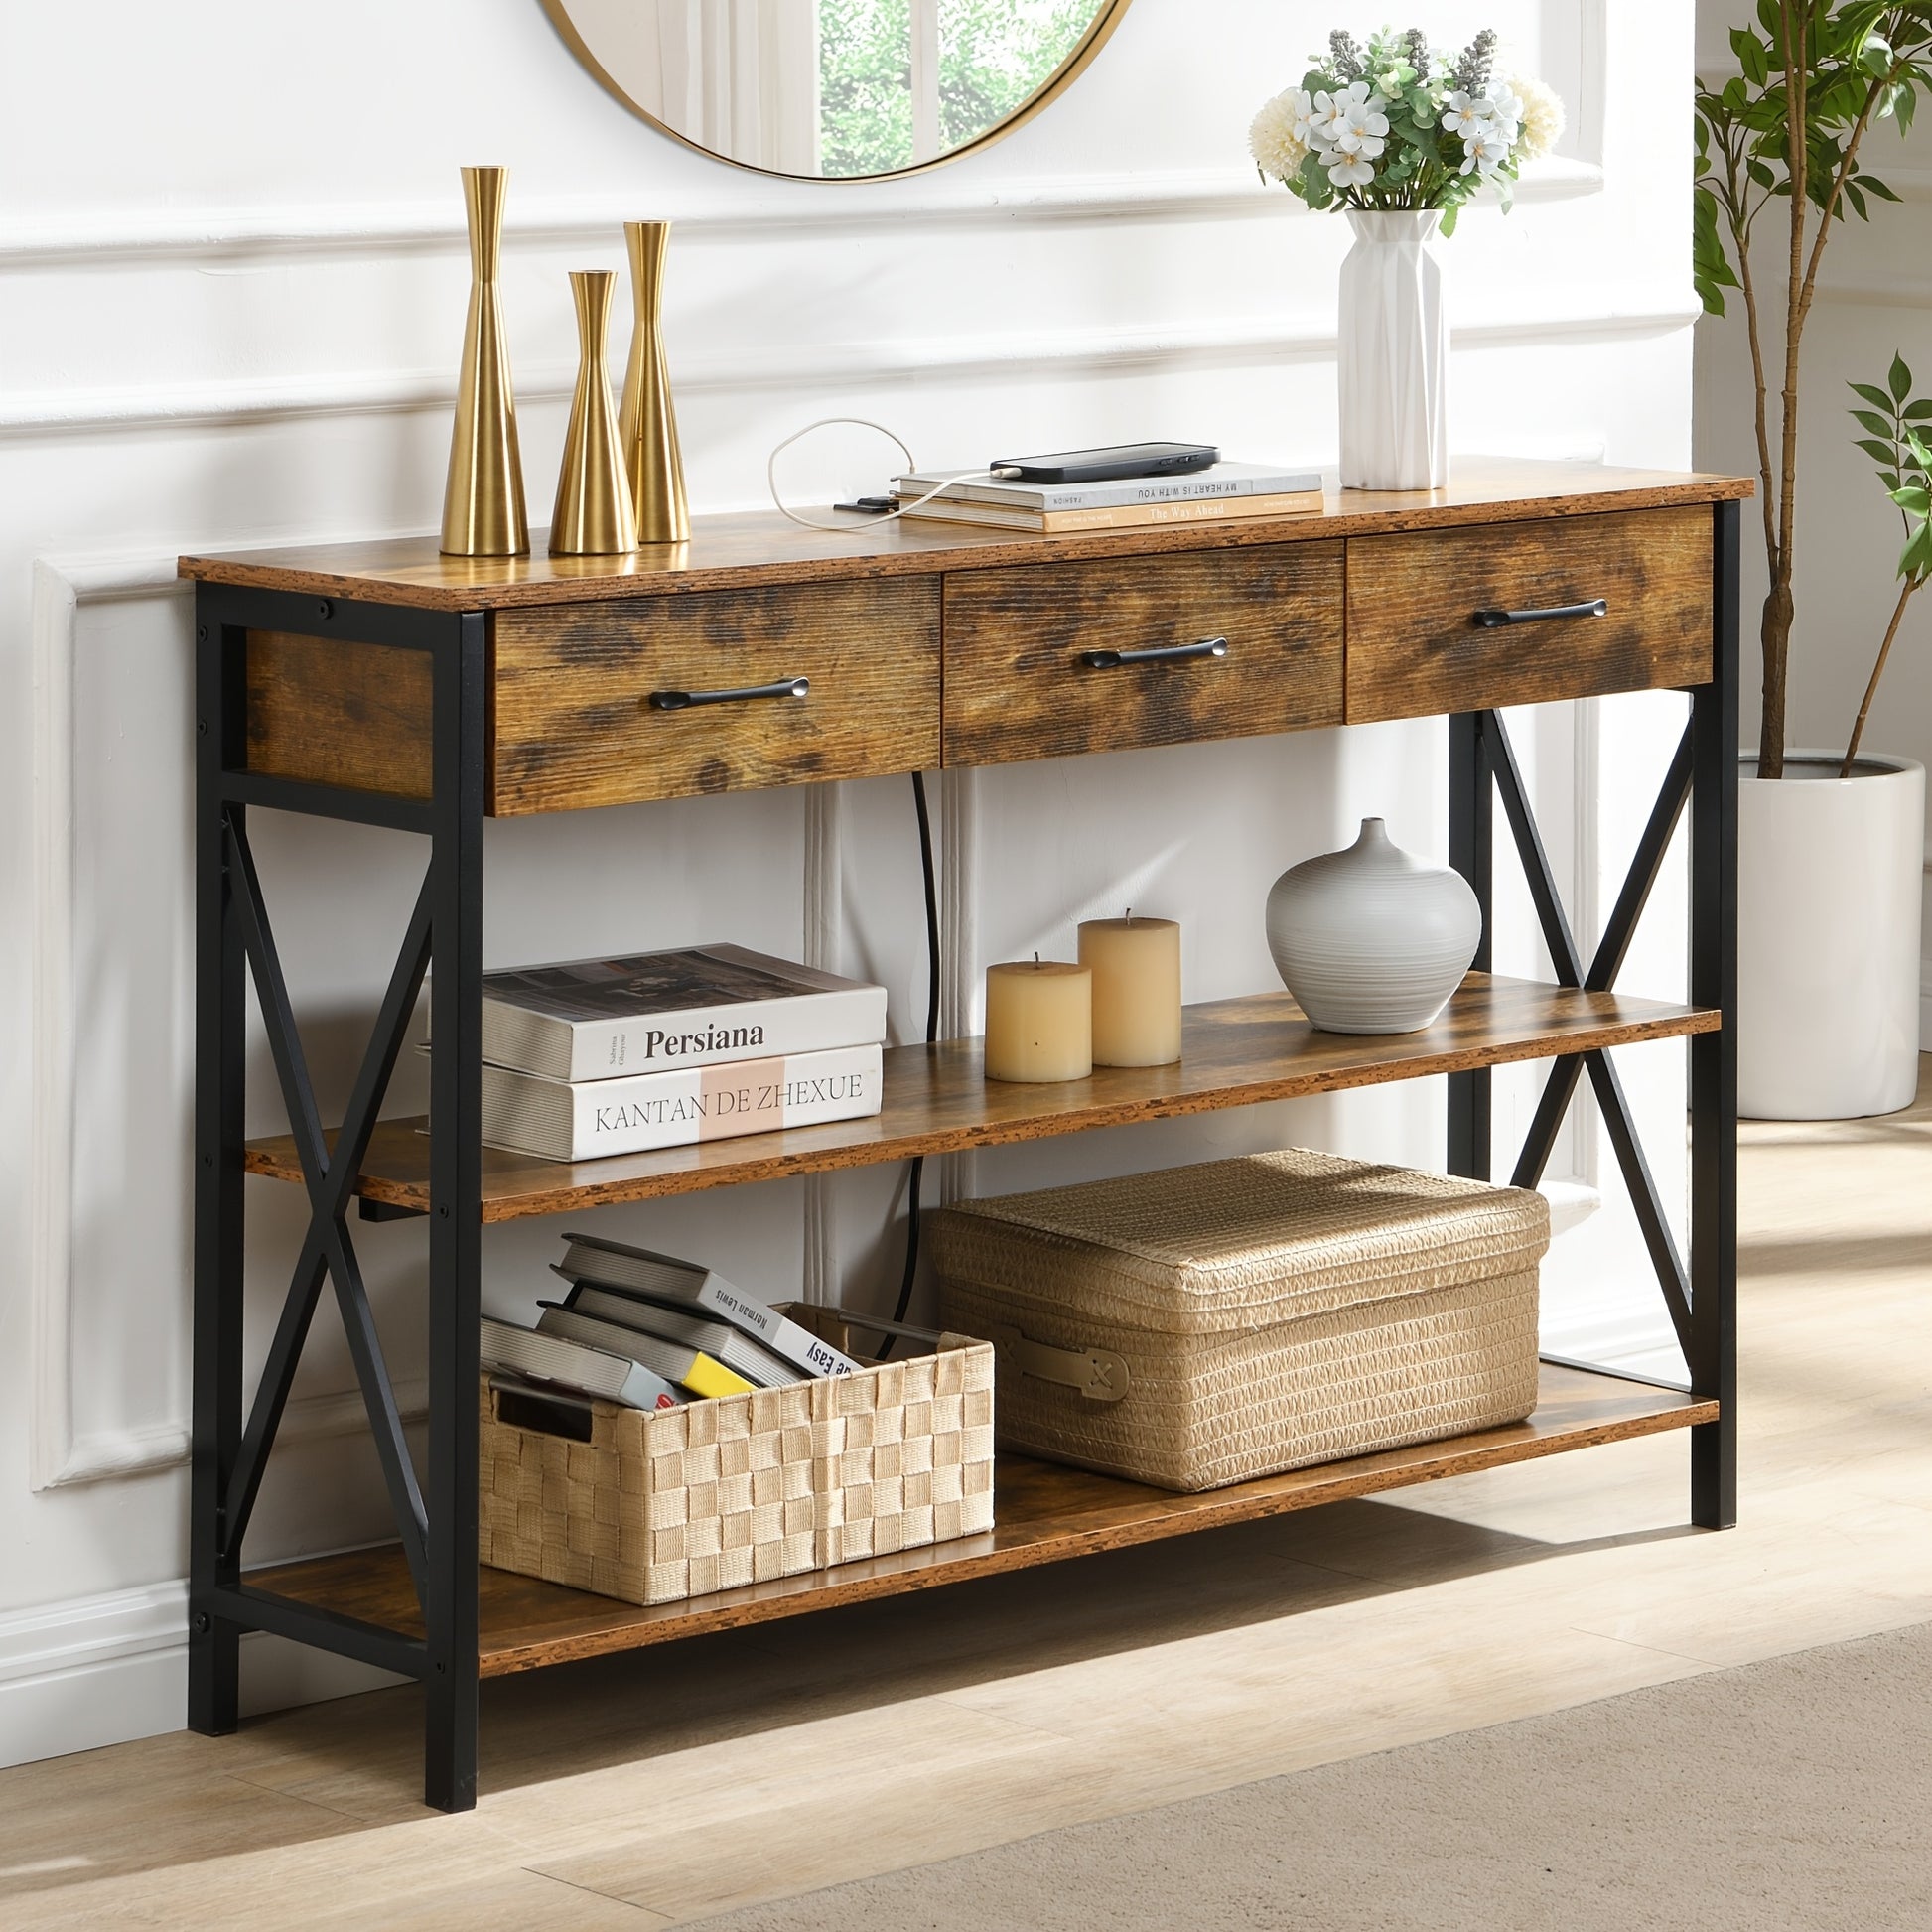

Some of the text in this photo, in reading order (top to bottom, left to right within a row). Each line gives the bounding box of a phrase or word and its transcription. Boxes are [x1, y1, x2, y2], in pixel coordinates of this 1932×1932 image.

[1138, 483, 1237, 499] MY HEART IS WITH YOU
[1150, 503, 1224, 519] The Way Ahead
[644, 1023, 764, 1059] Persiana
[596, 1073, 863, 1133] KANTAN DE ZHEXUE
[715, 1289, 768, 1330] Norman Lewis
[806, 1341, 835, 1374] Easy
